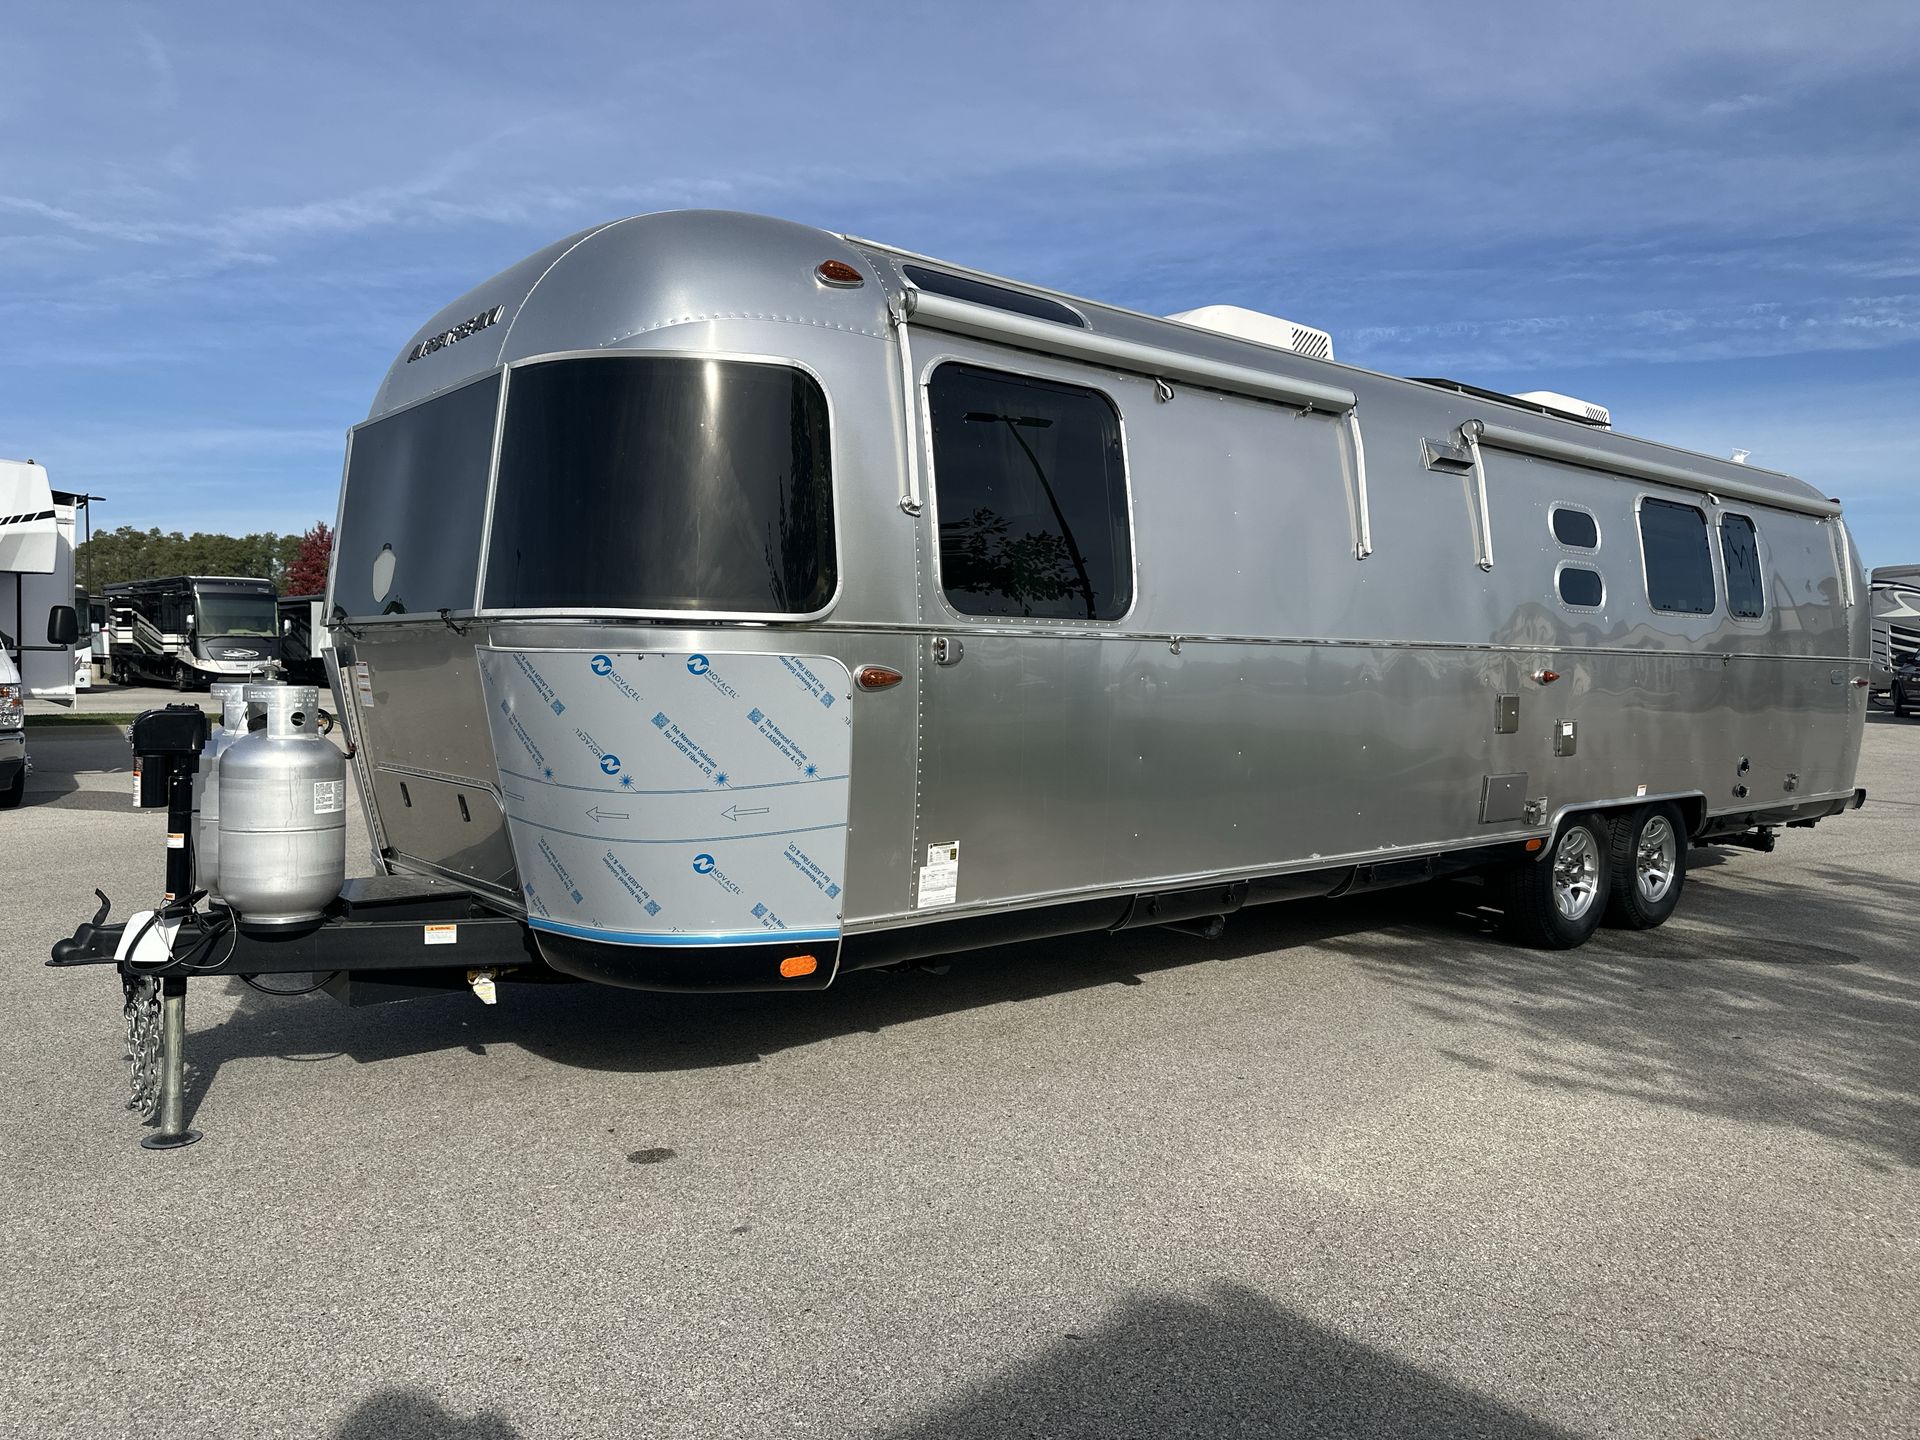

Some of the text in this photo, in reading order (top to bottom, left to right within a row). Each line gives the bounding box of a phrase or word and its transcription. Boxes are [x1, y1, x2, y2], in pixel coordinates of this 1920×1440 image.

[779, 656, 820, 698] The Novacel Solution
[794, 659, 806, 672] Fiber
[804, 669, 819, 685] LASER
[610, 670, 640, 702] NOVACEL
[707, 669, 736, 699] NOVACEL
[575, 728, 602, 759] NOVACEL
[664, 730, 672, 739] for
[671, 737, 688, 754] LASER
[687, 751, 700, 764] Fiber
[671, 724, 717, 769] The Novacel Solution
[765, 719, 807, 761] The Novacel Solution
[765, 732, 781, 748] LASER
[780, 744, 791, 757] Fiber
[617, 864, 629, 877] Fiber
[784, 850, 824, 890] The Novacel Solution
[800, 853, 811, 866] Fiber
[810, 863, 825, 878] LASER
[603, 857, 643, 904] The Novacel Solution
[627, 875, 643, 892] LASER
[712, 868, 740, 895] NOVACEL
[823, 875, 831, 883] for
[762, 919, 770, 927] for
[769, 912, 777, 922] The
